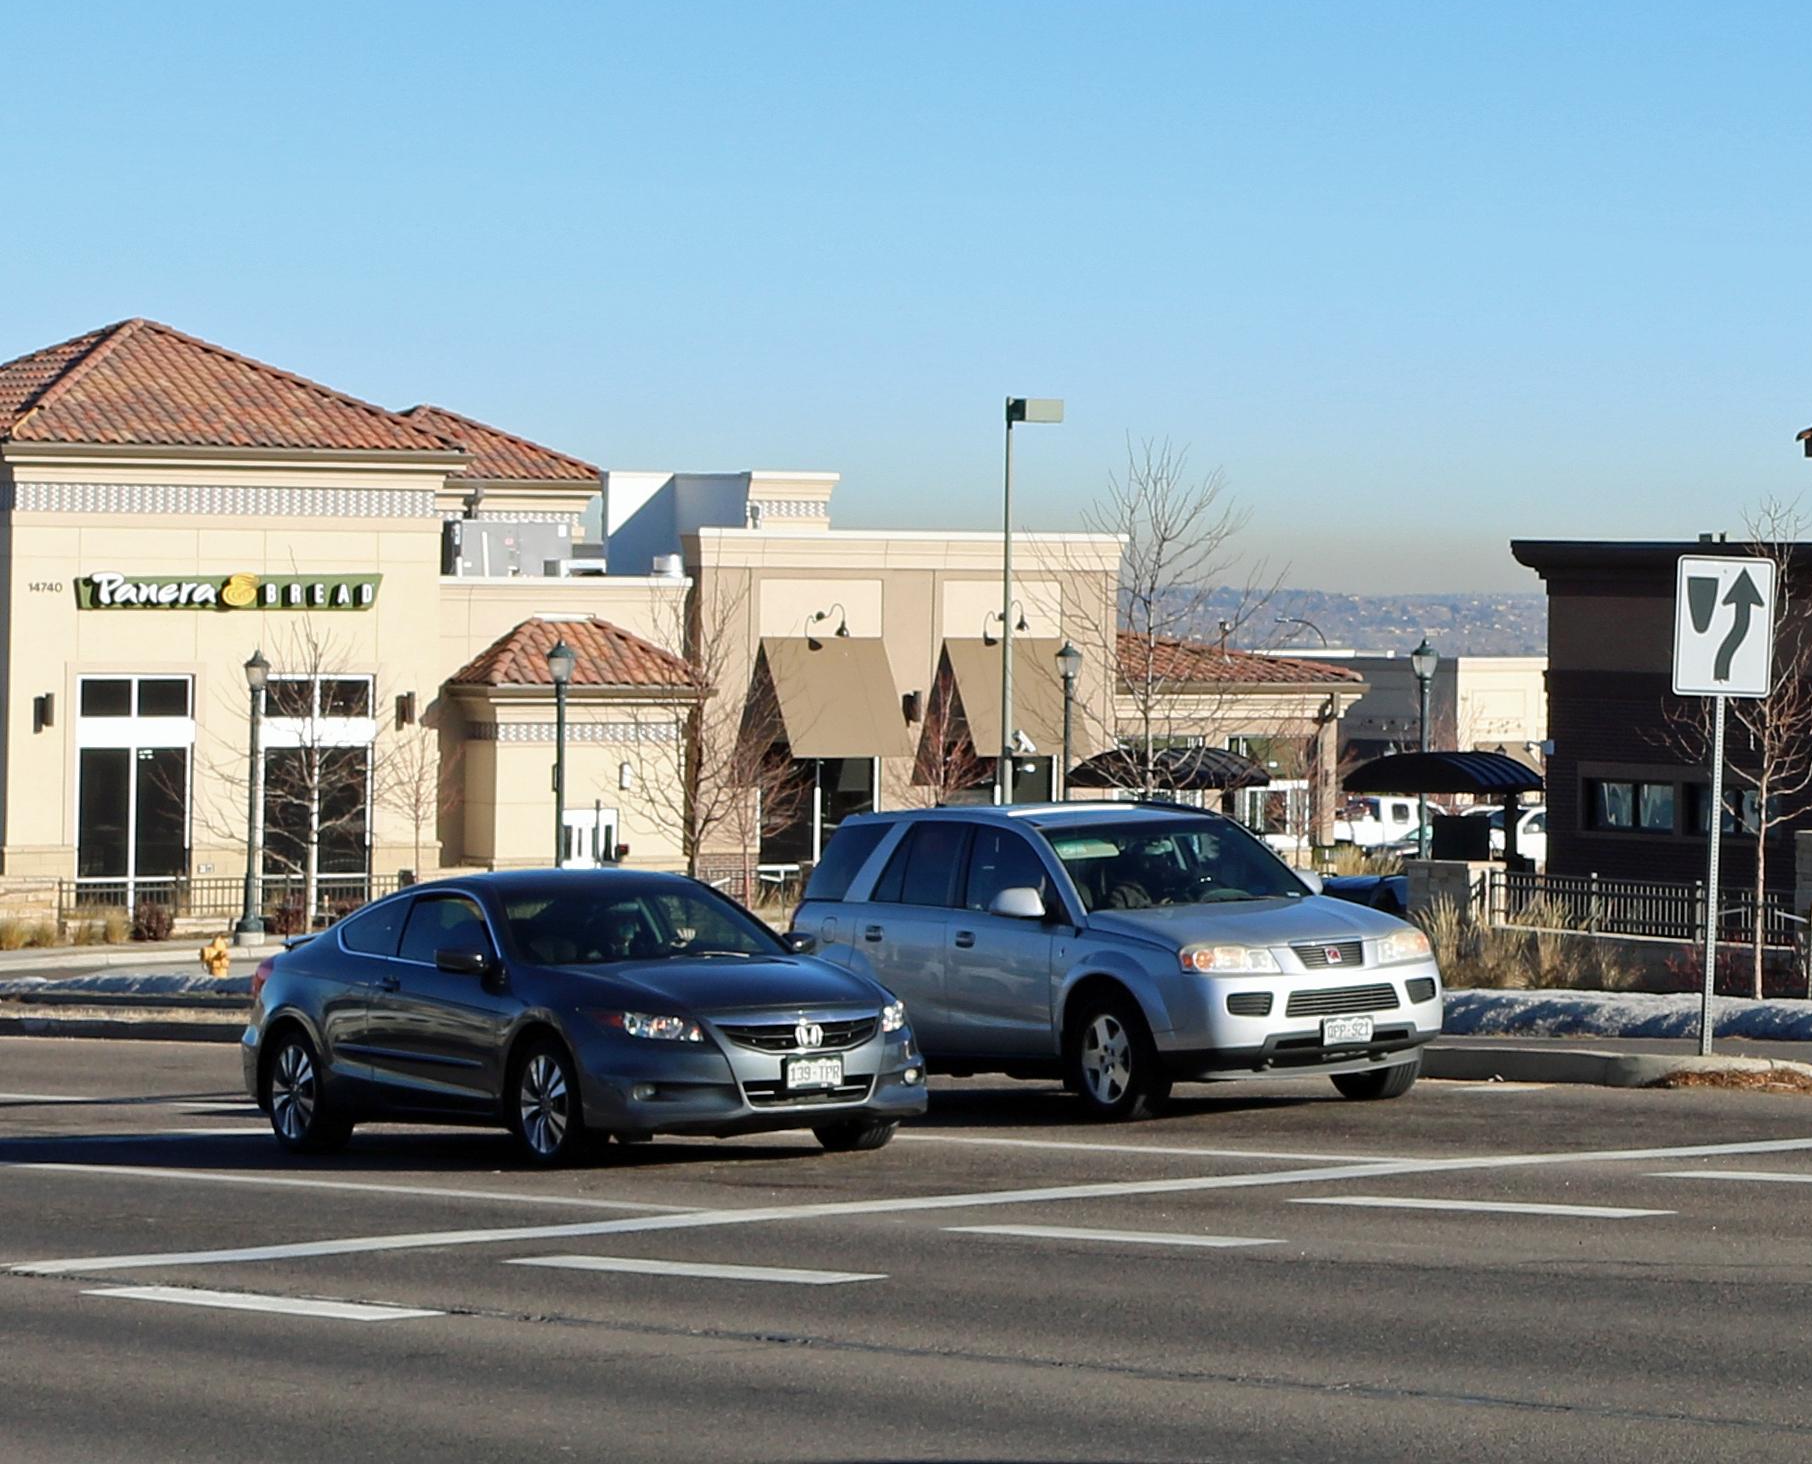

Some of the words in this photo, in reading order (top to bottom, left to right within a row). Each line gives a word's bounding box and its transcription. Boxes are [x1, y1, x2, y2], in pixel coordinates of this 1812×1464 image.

[28, 582, 63, 593] 14740
[91, 572, 219, 606] Panera
[266, 583, 374, 604] BREAD
